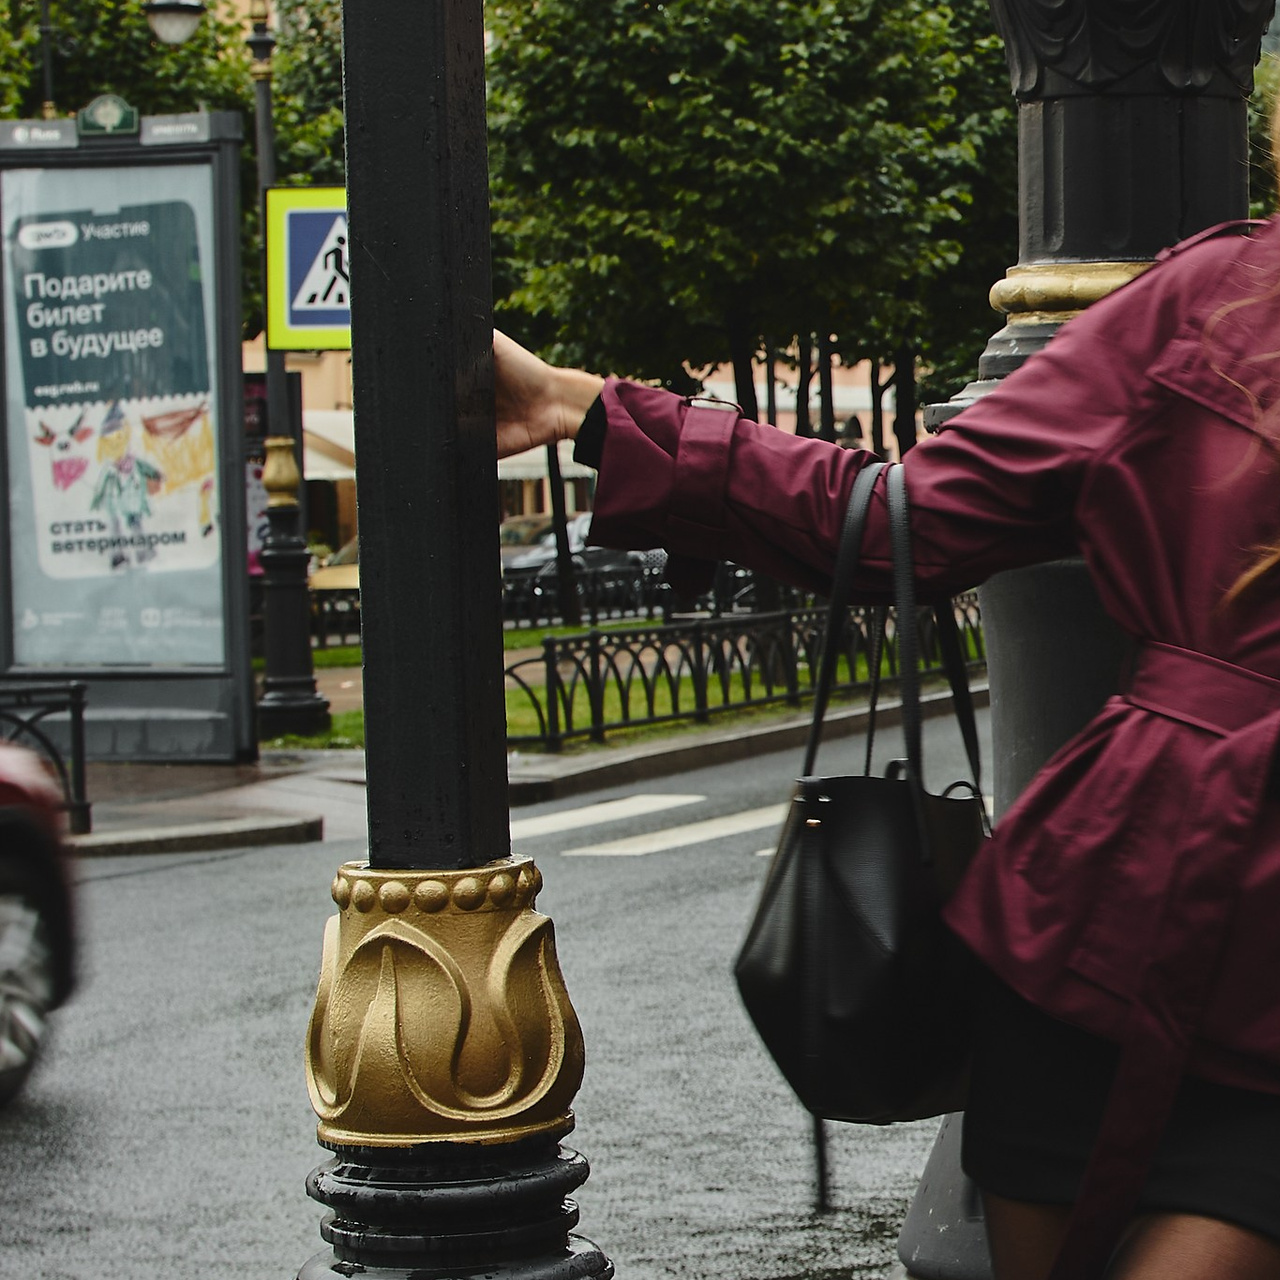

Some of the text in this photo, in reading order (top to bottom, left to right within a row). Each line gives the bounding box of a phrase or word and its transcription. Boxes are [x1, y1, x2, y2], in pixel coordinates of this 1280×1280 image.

[81, 220, 150, 240] Участие
[24, 270, 152, 299] Подарите
[27, 302, 106, 328] билет
[30, 328, 164, 360] в будущее
[50, 519, 107, 534] стать
[51, 531, 186, 554] ветеринаром
